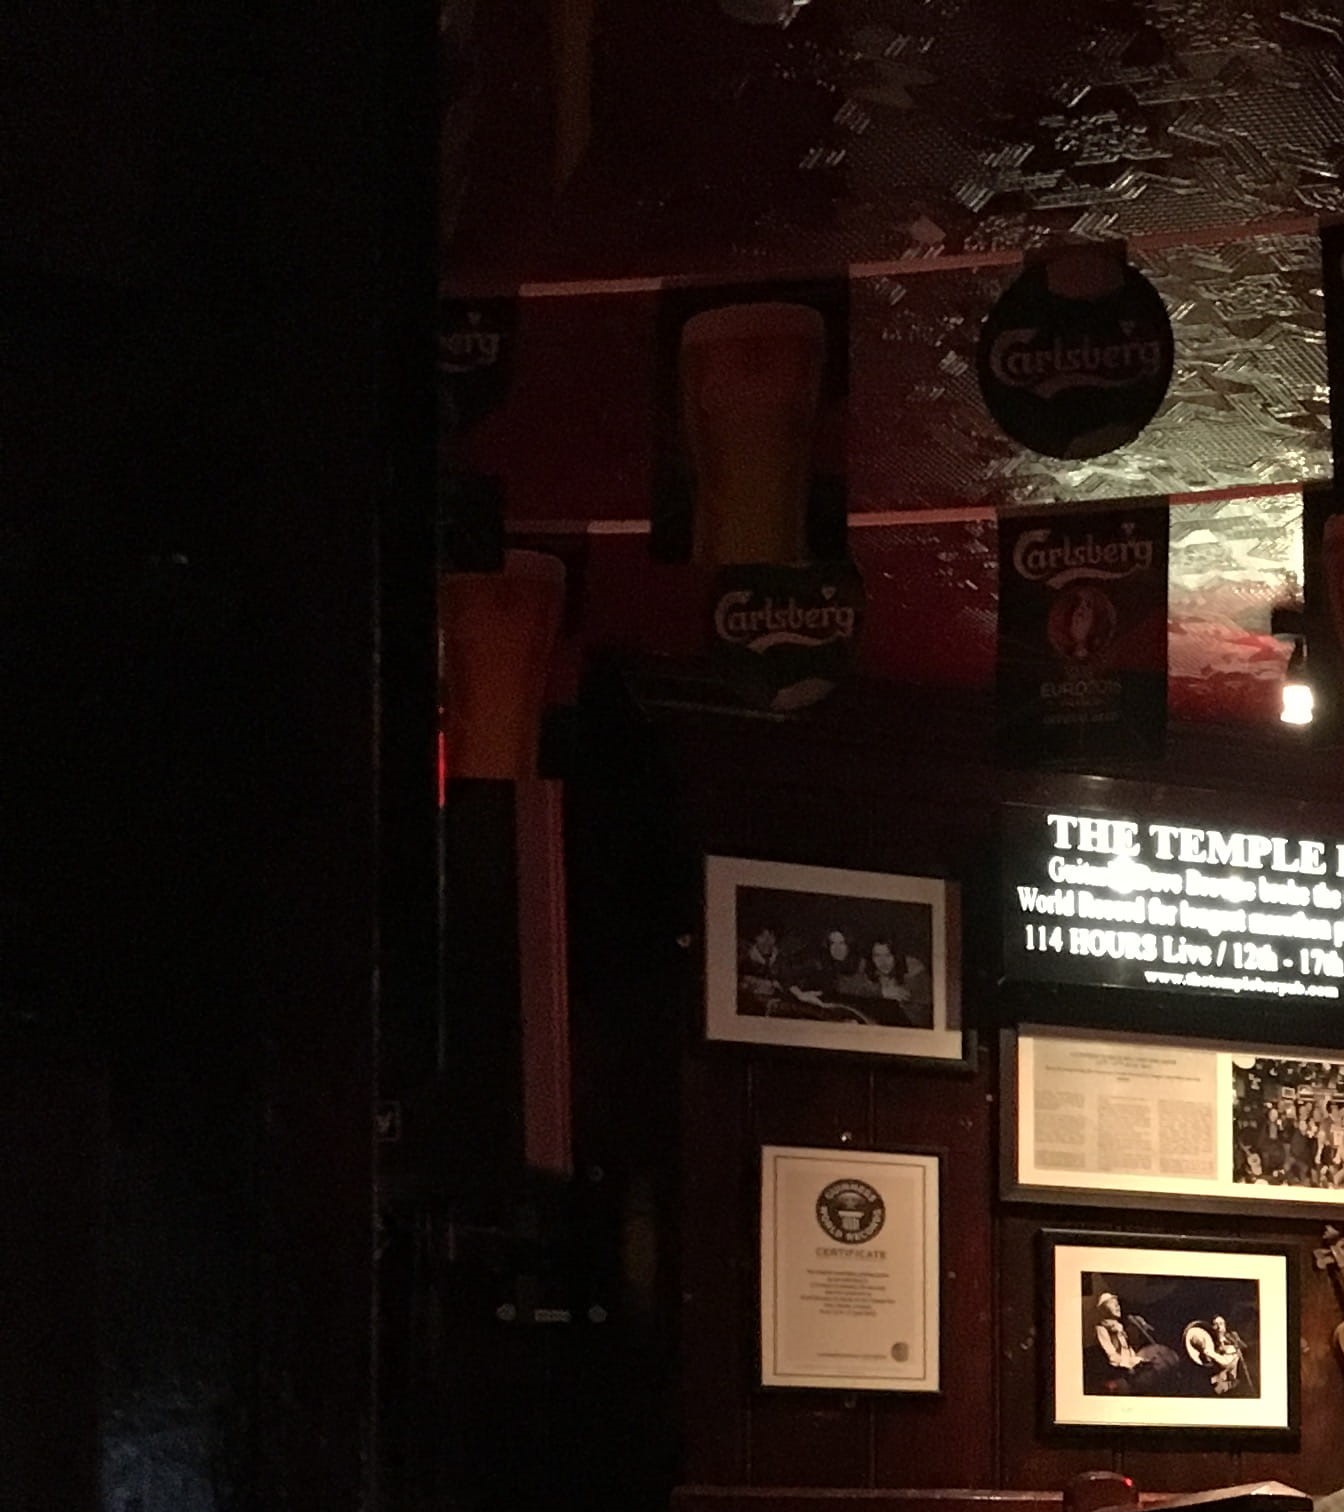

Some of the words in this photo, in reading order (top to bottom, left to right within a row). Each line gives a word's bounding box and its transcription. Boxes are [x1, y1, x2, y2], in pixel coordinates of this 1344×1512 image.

[988, 325, 1163, 399] Carlsberg
[1012, 525, 1154, 588] Carlsberg
[713, 588, 856, 654] Carlsberg
[1047, 814, 1140, 857] THE
[1149, 824, 1327, 876] TEMPLE
[1017, 886, 1075, 917] World
[1025, 924, 1063, 952] 114
[1069, 927, 1158, 961] HOURS
[1162, 935, 1212, 966] Live
[1233, 942, 1279, 972] 12th
[1300, 948, 1344, 978] 17th
